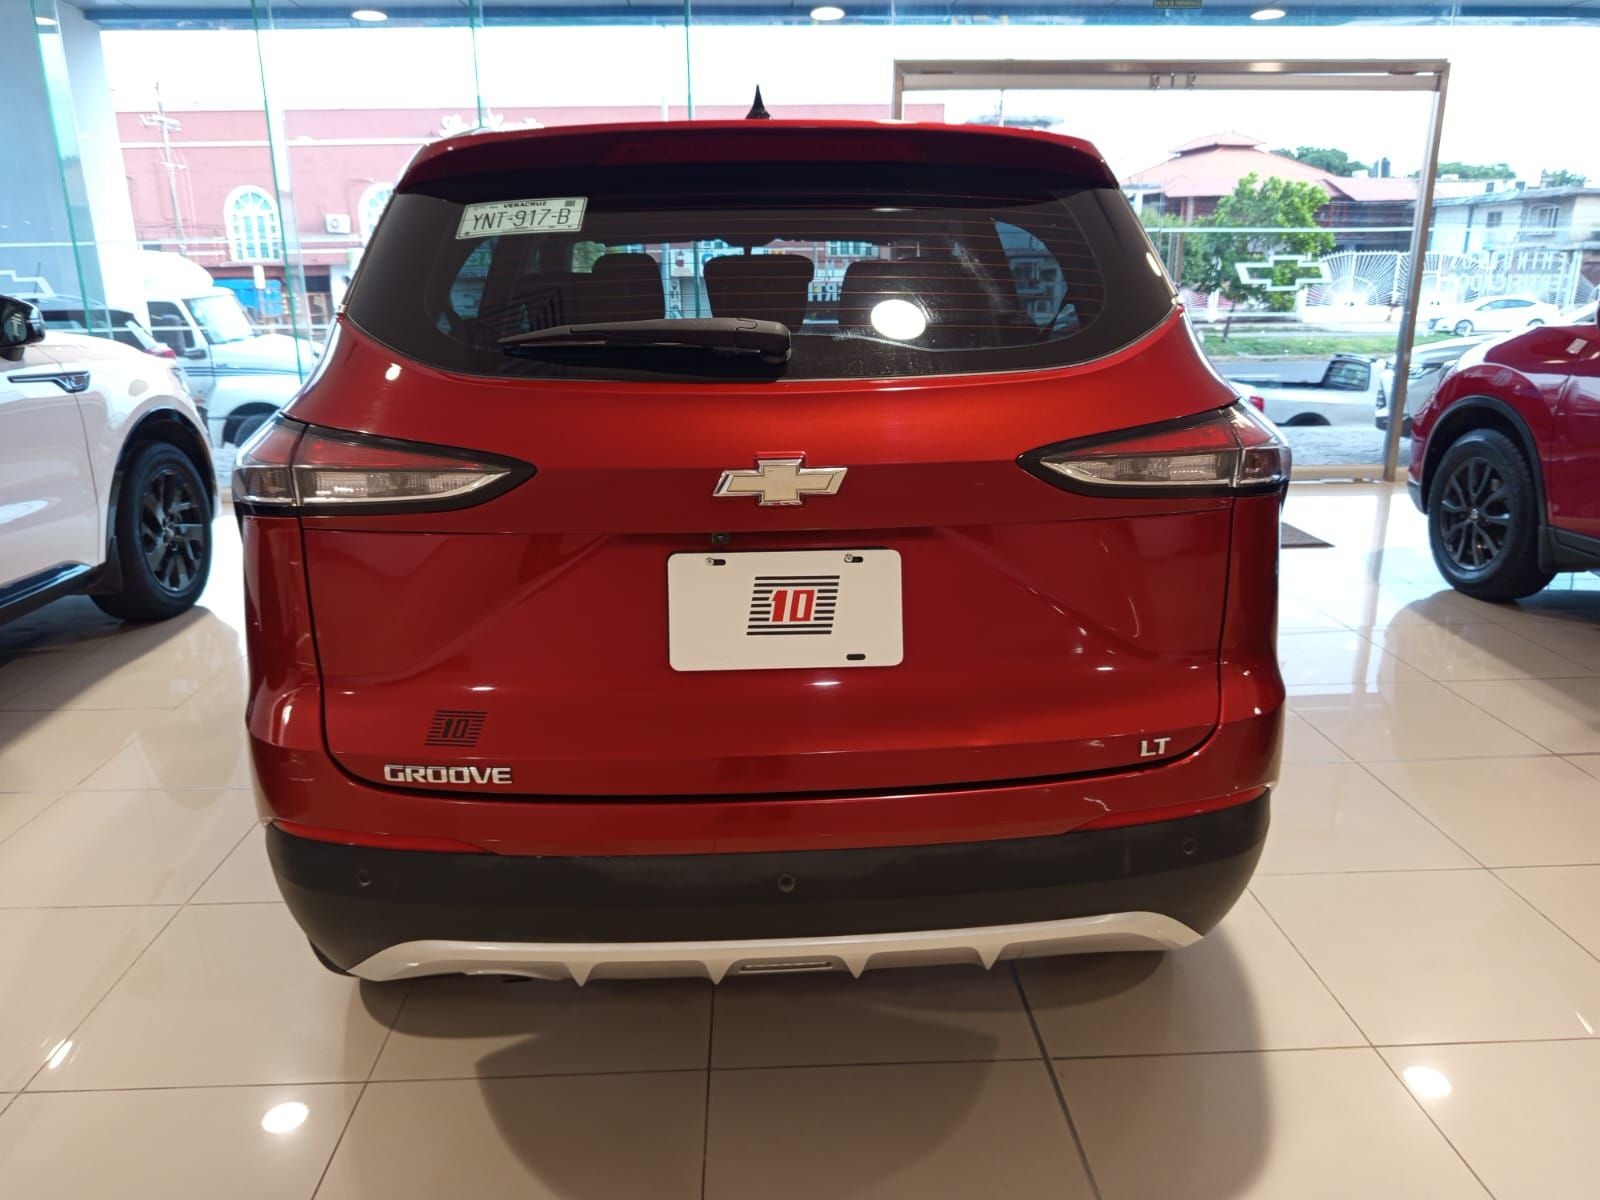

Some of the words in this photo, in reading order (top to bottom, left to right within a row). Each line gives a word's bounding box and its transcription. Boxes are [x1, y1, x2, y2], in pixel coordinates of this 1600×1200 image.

[473, 208, 571, 230] YNT-917-B
[770, 588, 816, 623] 10
[442, 718, 469, 738] 10
[1140, 737, 1171, 757] LT
[383, 764, 513, 785] GROOVE
